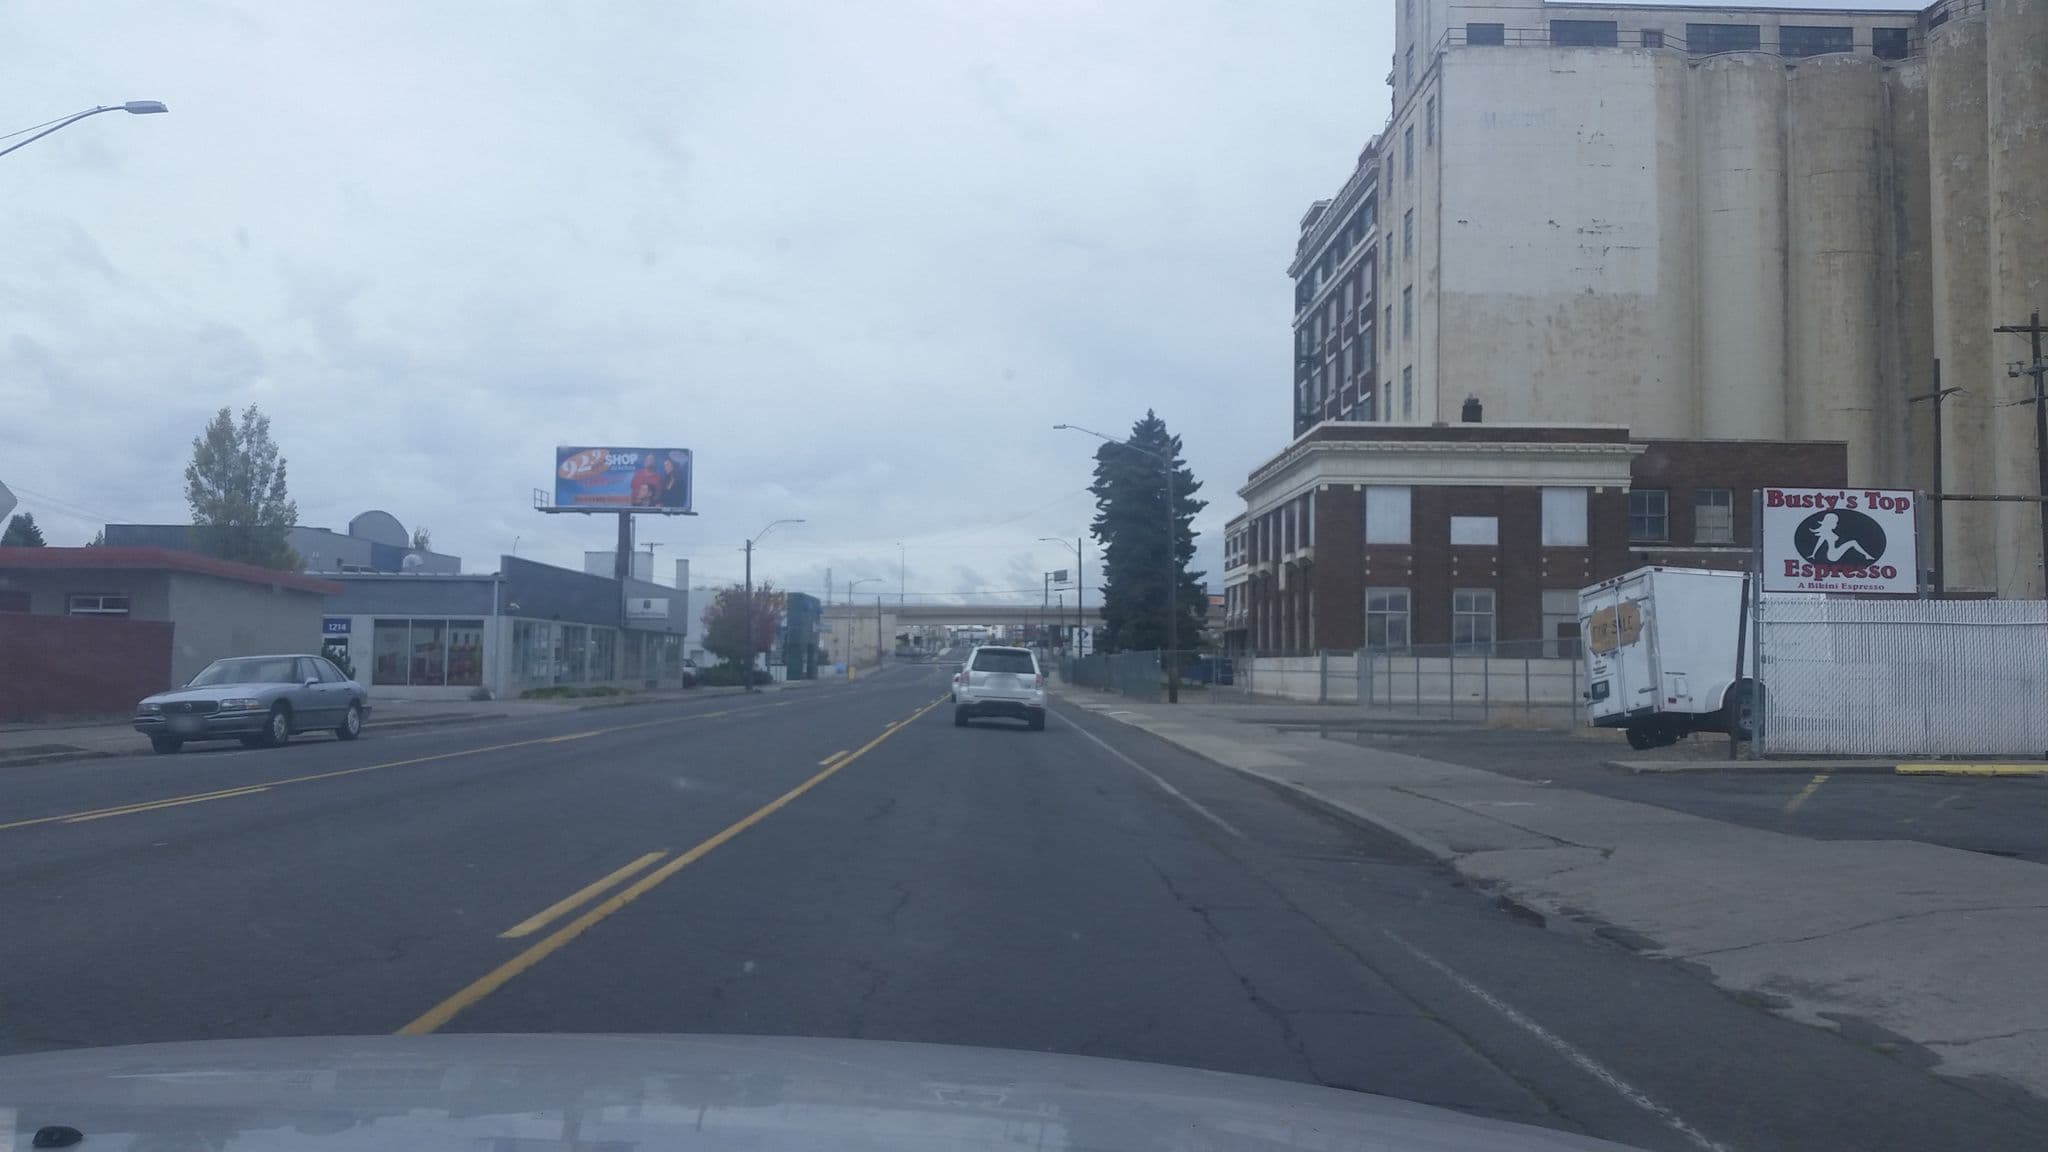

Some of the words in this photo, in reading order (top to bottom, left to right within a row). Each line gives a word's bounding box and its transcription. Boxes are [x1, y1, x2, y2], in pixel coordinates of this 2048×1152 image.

[605, 453, 639, 466] SHOP
[1766, 489, 1858, 512] Busty's
[1864, 491, 1911, 514] Top
[1783, 559, 1897, 581] Espresso
[1808, 582, 1839, 590] Bikini
[1841, 582, 1885, 591] Espresso
